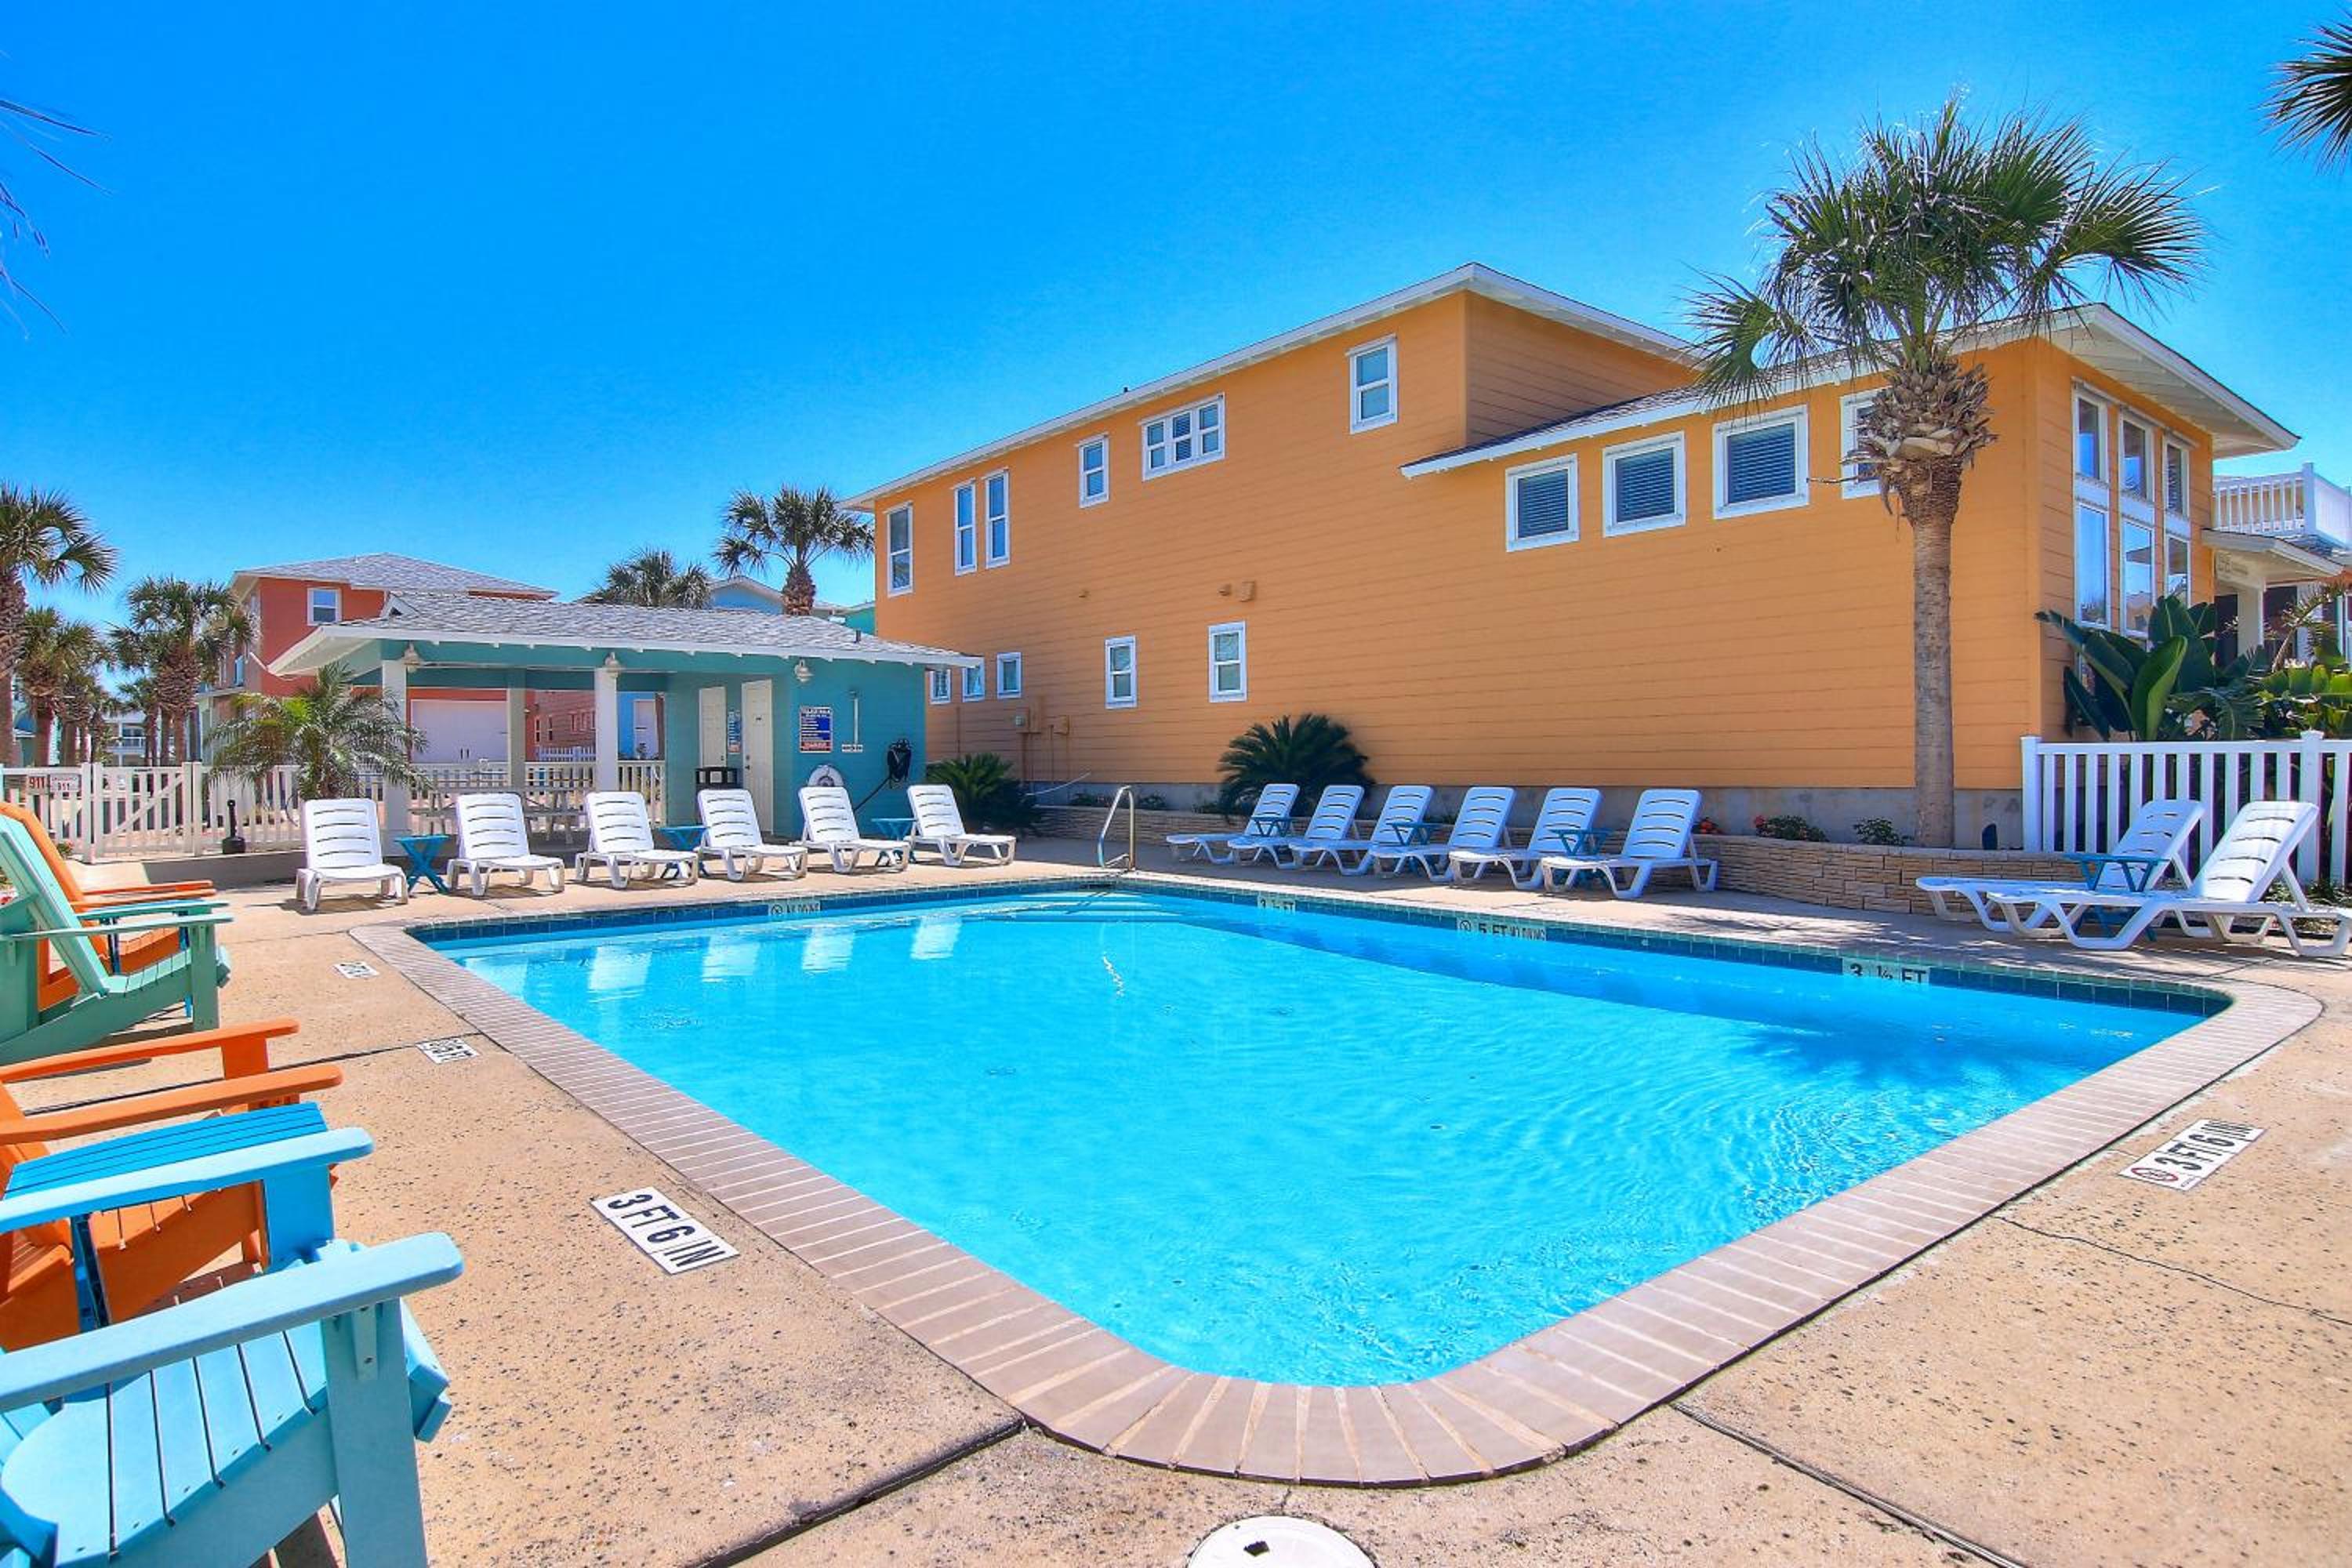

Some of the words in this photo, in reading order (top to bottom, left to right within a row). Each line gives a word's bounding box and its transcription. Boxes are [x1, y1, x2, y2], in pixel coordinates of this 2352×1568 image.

[29, 776, 45, 789] 911
[1492, 924, 1508, 936] FT
[1850, 963, 1863, 977] 3
[1901, 968, 1926, 983] FT
[2201, 1120, 2253, 1141] IN
[2188, 1134, 2235, 1147] 6
[2167, 1142, 2223, 1163] FT
[2154, 1156, 2202, 1171] 3
[608, 1194, 653, 1210] 3
[621, 1205, 681, 1228] FT
[647, 1225, 695, 1243] 6
[663, 1240, 726, 1267] IN
